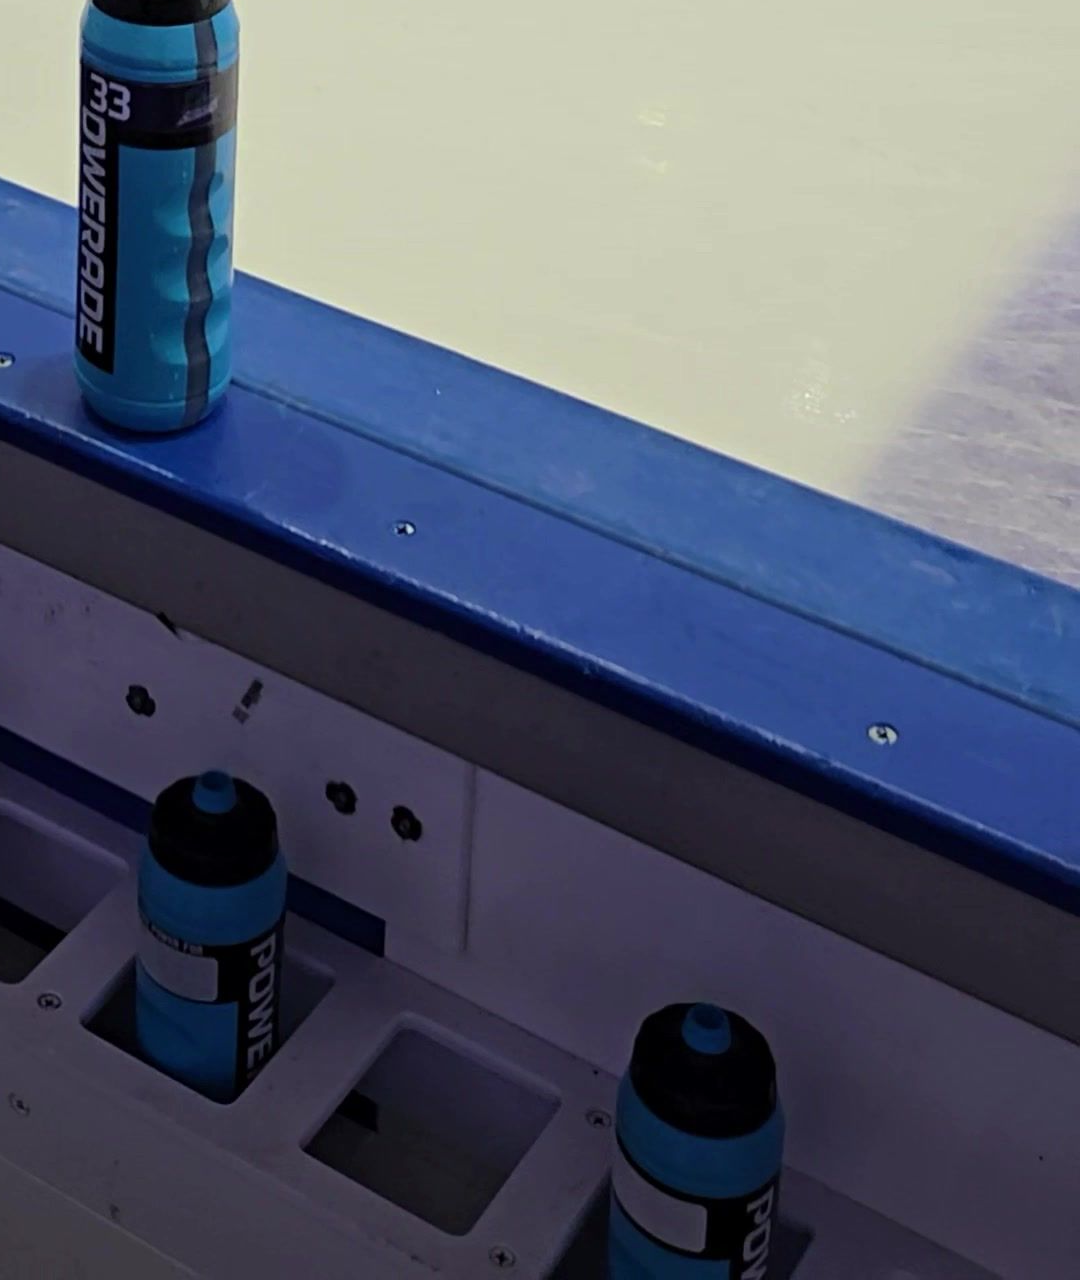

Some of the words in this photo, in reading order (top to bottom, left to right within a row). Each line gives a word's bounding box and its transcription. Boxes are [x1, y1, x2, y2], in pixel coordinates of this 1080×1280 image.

[90, 72, 131, 121] 33
[80, 105, 108, 354] OWERADE
[247, 932, 276, 1074] POWE
